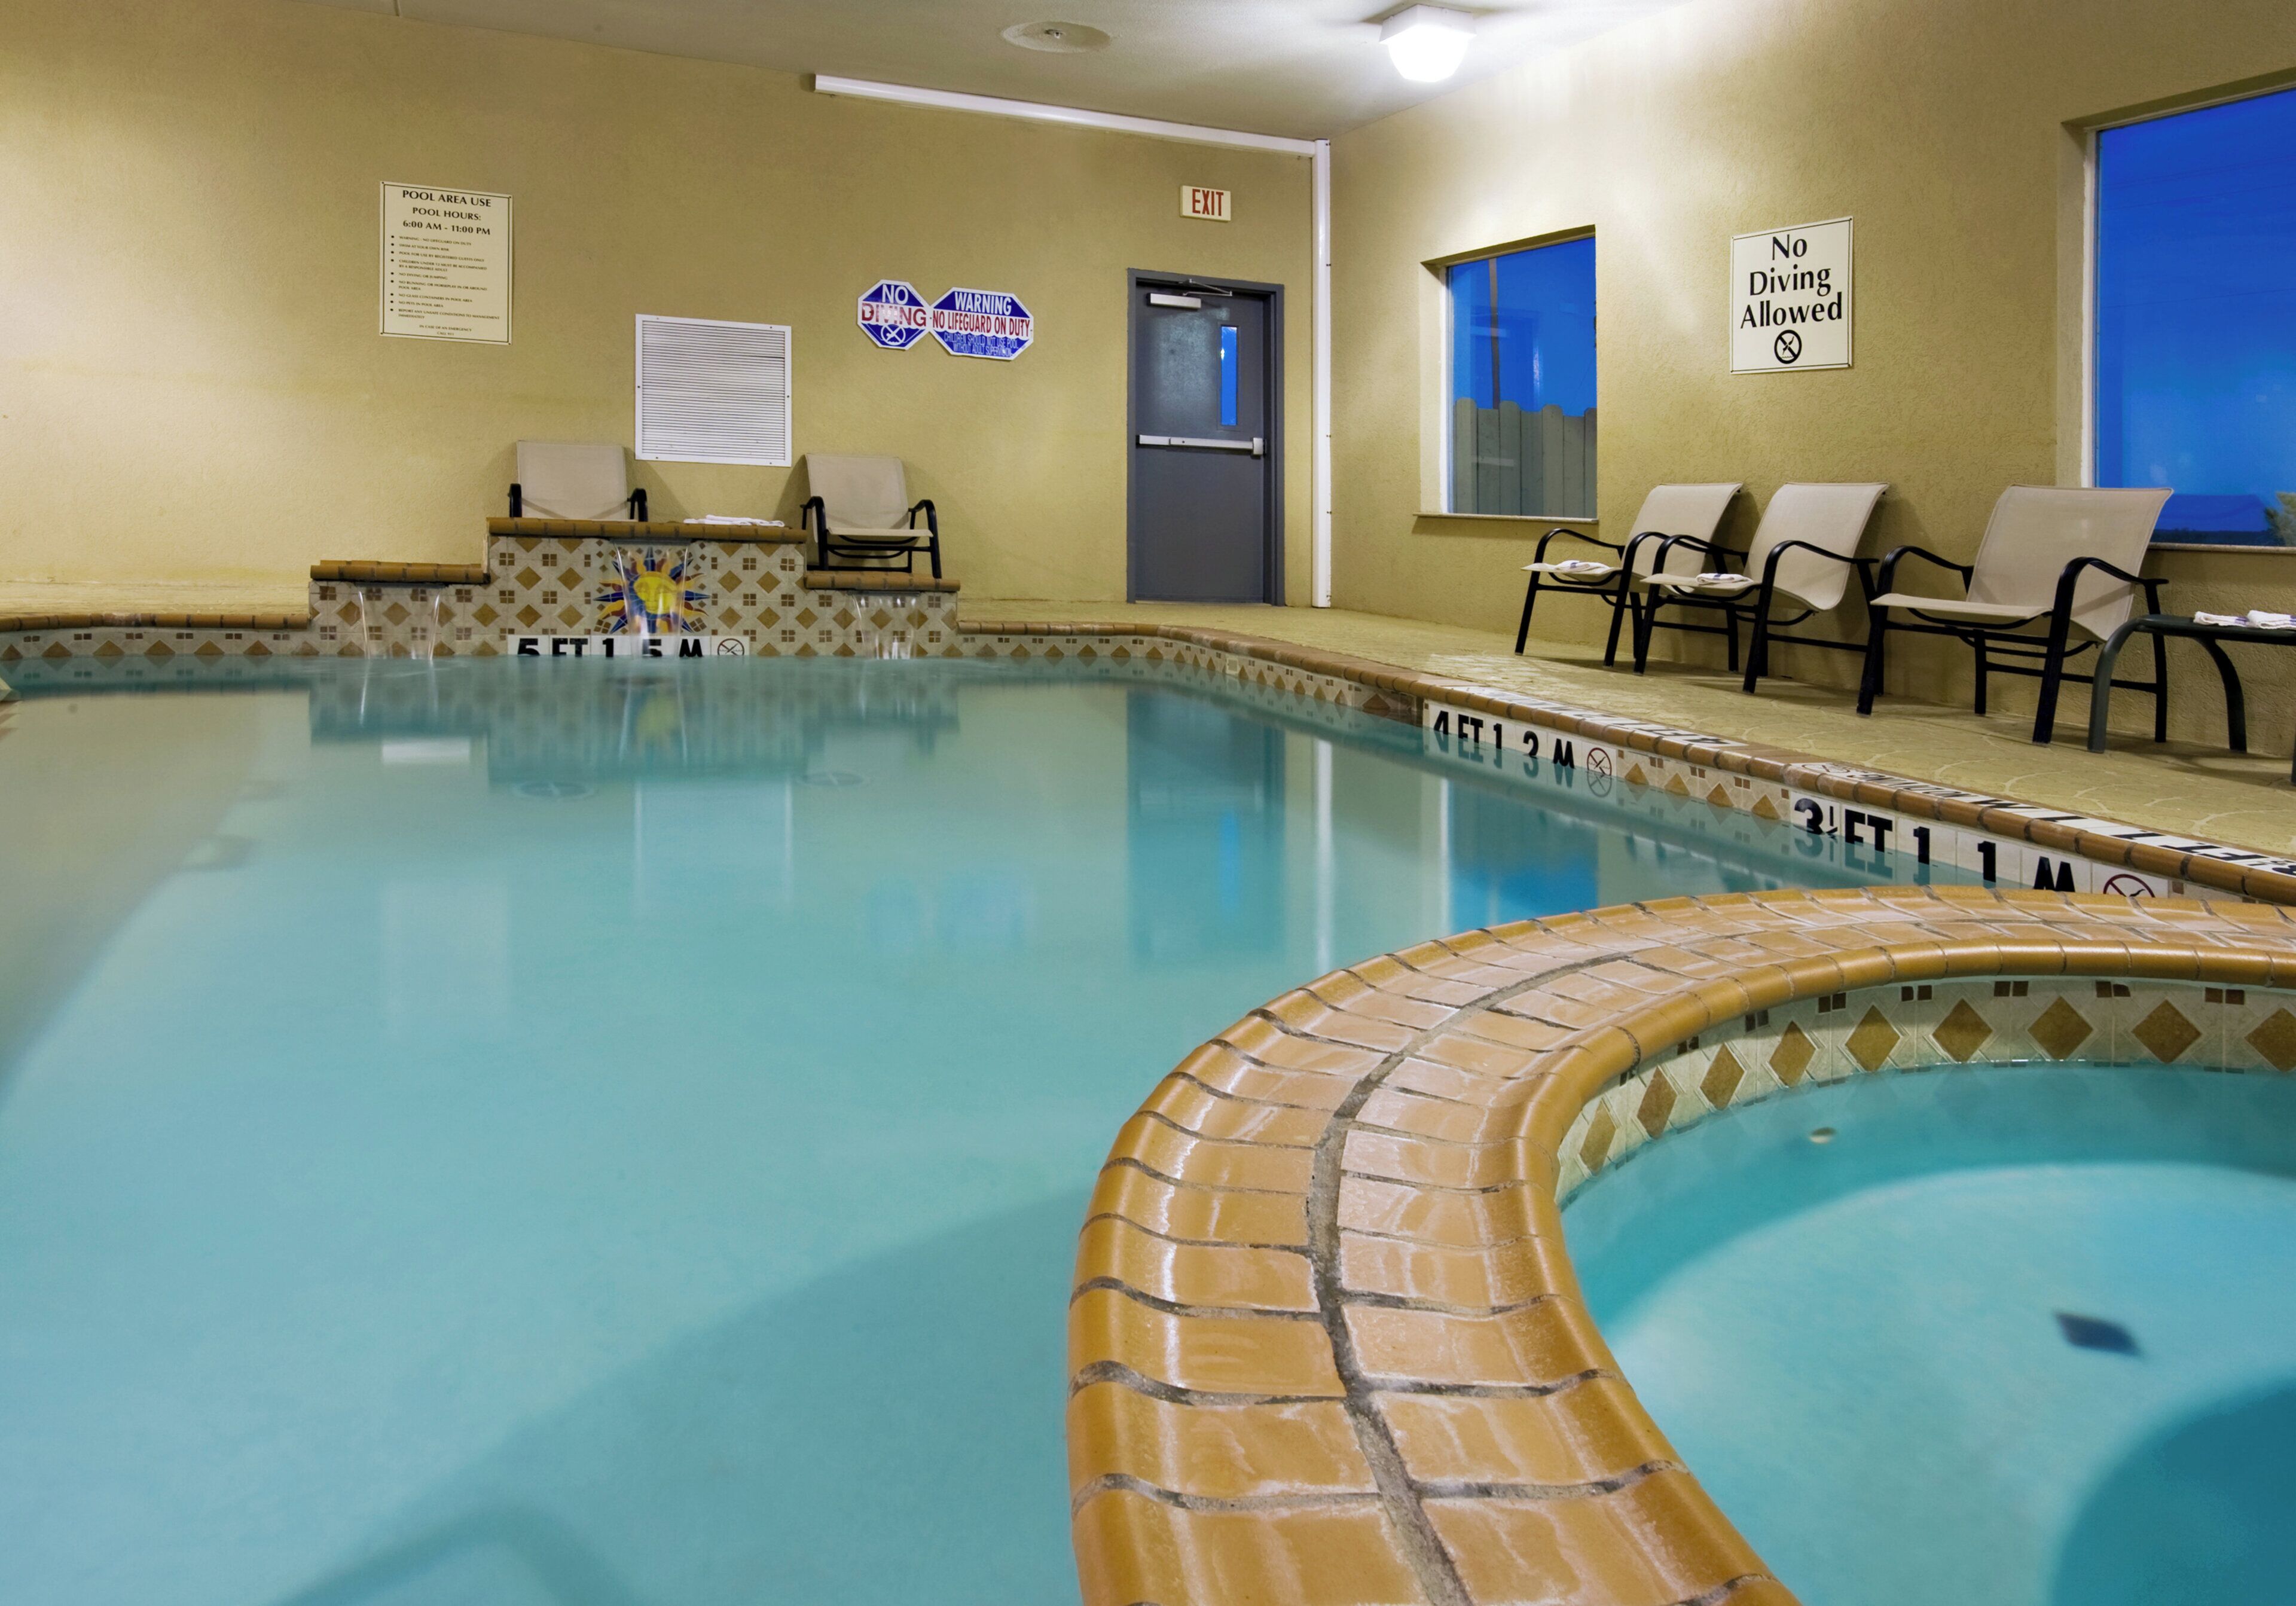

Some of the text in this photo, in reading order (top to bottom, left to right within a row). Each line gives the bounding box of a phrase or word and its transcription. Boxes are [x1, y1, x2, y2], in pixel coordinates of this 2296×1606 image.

[402, 190, 491, 207] POOL AREA USE
[1192, 188, 1224, 216] EXIT
[413, 207, 481, 221] POOL HOURS:
[451, 225, 473, 233] 11:00
[1772, 234, 1807, 261] No
[1750, 264, 1831, 297] Diving
[882, 284, 908, 305] NO
[954, 292, 1012, 315] WARNING
[1741, 291, 1842, 329] Allowed
[933, 310, 1030, 337] NO LIFEGUARD ON DUTY
[944, 332, 966, 343] CHILDREN
[967, 334, 985, 346] SHOULD
[987, 337, 996, 346] NOT
[1007, 338, 1019, 349] POOL
[953, 343, 970, 353] WITHOUT
[972, 344, 985, 355] ADULT
[517, 638, 541, 656] 5
[552, 638, 588, 656] FT
[679, 639, 703, 657] M
[1458, 714, 1483, 743] FT
[1553, 738, 1575, 769] M
[1845, 809, 1892, 853] FT
[1978, 841, 1996, 883] 1
[2034, 856, 2075, 892] M
